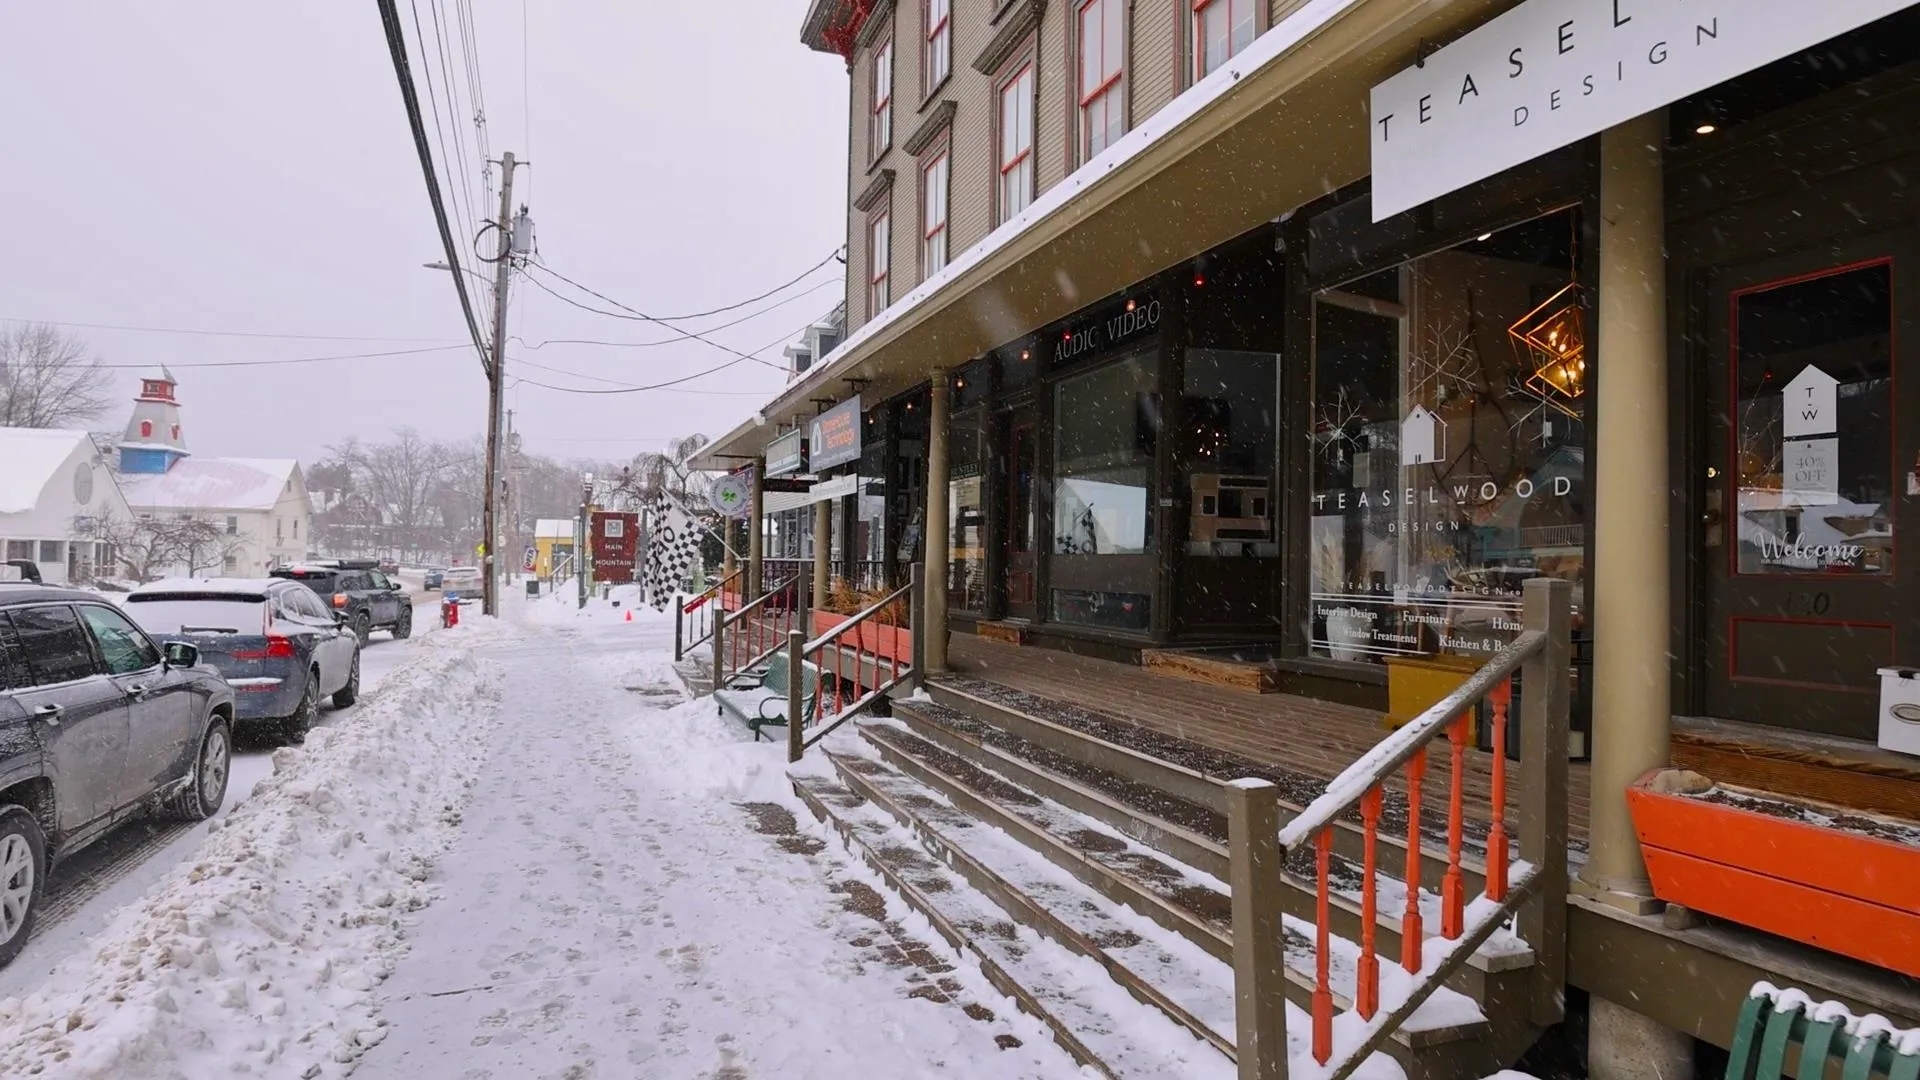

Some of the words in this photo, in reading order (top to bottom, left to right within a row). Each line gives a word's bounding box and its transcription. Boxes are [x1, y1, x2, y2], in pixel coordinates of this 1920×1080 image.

[1378, 0, 1684, 142] TEASEL
[1514, 17, 1718, 127] DESIGN
[1106, 300, 1161, 341] VIDEO
[1795, 470, 1826, 482] OFF
[1316, 476, 1571, 510] TEASELWOOD
[1388, 521, 1460, 533] DESIGN
[604, 543, 623, 551] MAIN
[1753, 531, 1864, 560] Welcome
[1317, 605, 1349, 619] Interior
[1350, 606, 1378, 622] Design
[1403, 611, 1449, 625] Furniture
[1372, 629, 1417, 645] Treatments
[1439, 635, 1479, 650] Kitchen
[1482, 639, 1491, 651] &
